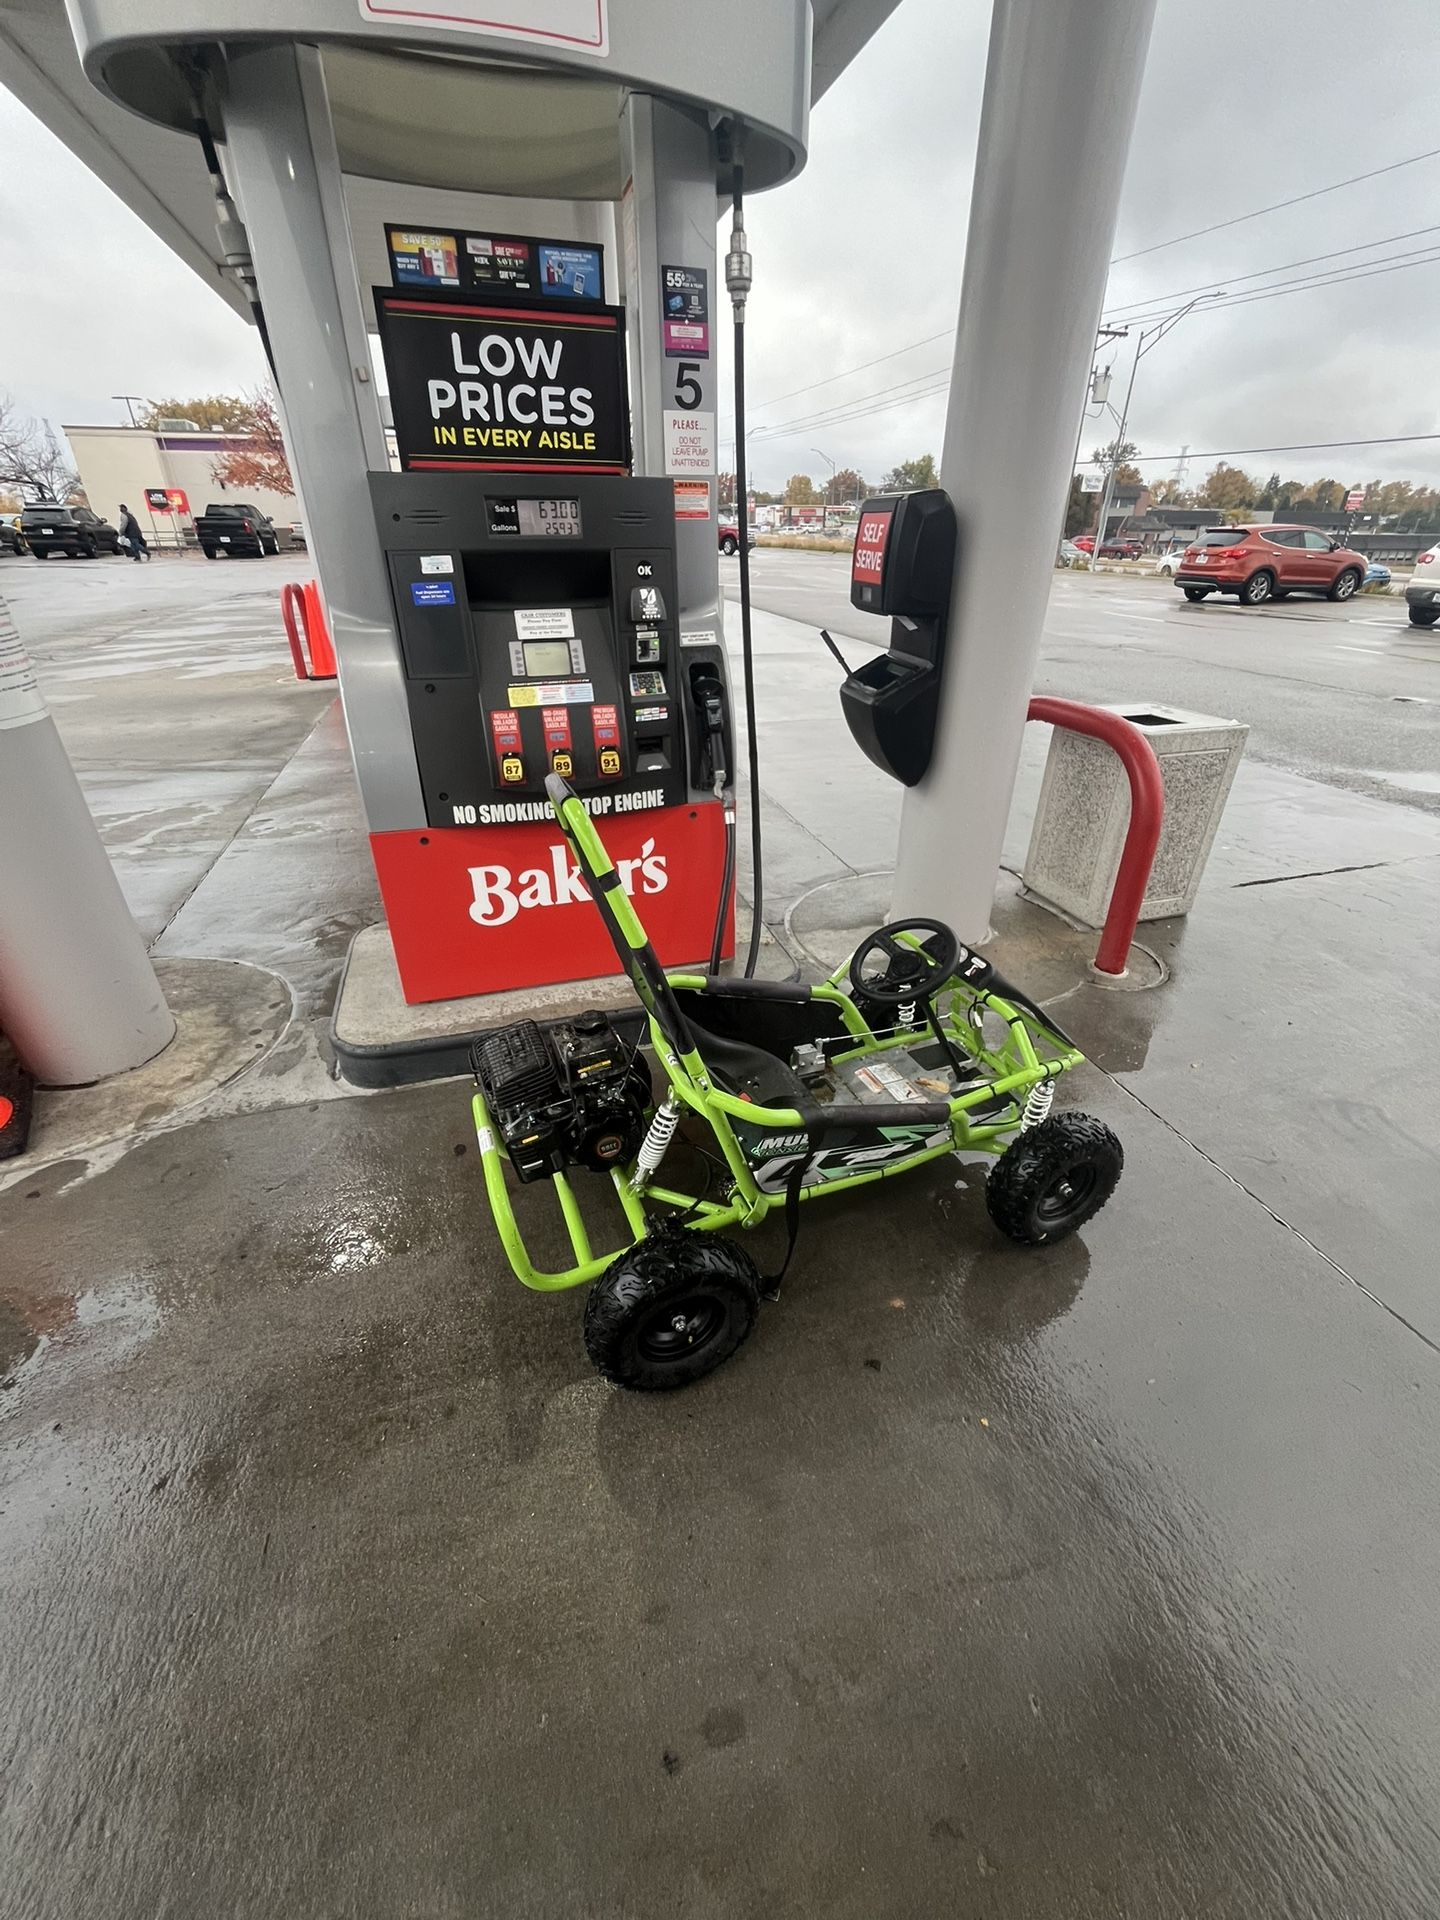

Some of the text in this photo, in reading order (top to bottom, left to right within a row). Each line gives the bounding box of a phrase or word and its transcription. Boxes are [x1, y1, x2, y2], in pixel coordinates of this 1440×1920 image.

[451, 332, 563, 380] LOW
[674, 362, 703, 411] 5
[427, 379, 595, 427] PRICES
[433, 426, 597, 450] IN EVERY AISLE
[679, 436, 702, 445] DO NOT
[672, 447, 709, 456] LEAVE PUMP
[671, 459, 710, 467] UNATTENDED
[494, 505, 516, 513] Sale $
[491, 524, 518, 532] Gallons
[862, 522, 885, 543] SELF
[855, 549, 883, 571] SERVE
[637, 565, 652, 576] OK
[555, 761, 570, 771] 89
[603, 758, 618, 768] 91
[505, 765, 520, 775] 87
[453, 789, 665, 824] NO SMOKING TOP ENGINE
[467, 837, 669, 927] Bakr's
